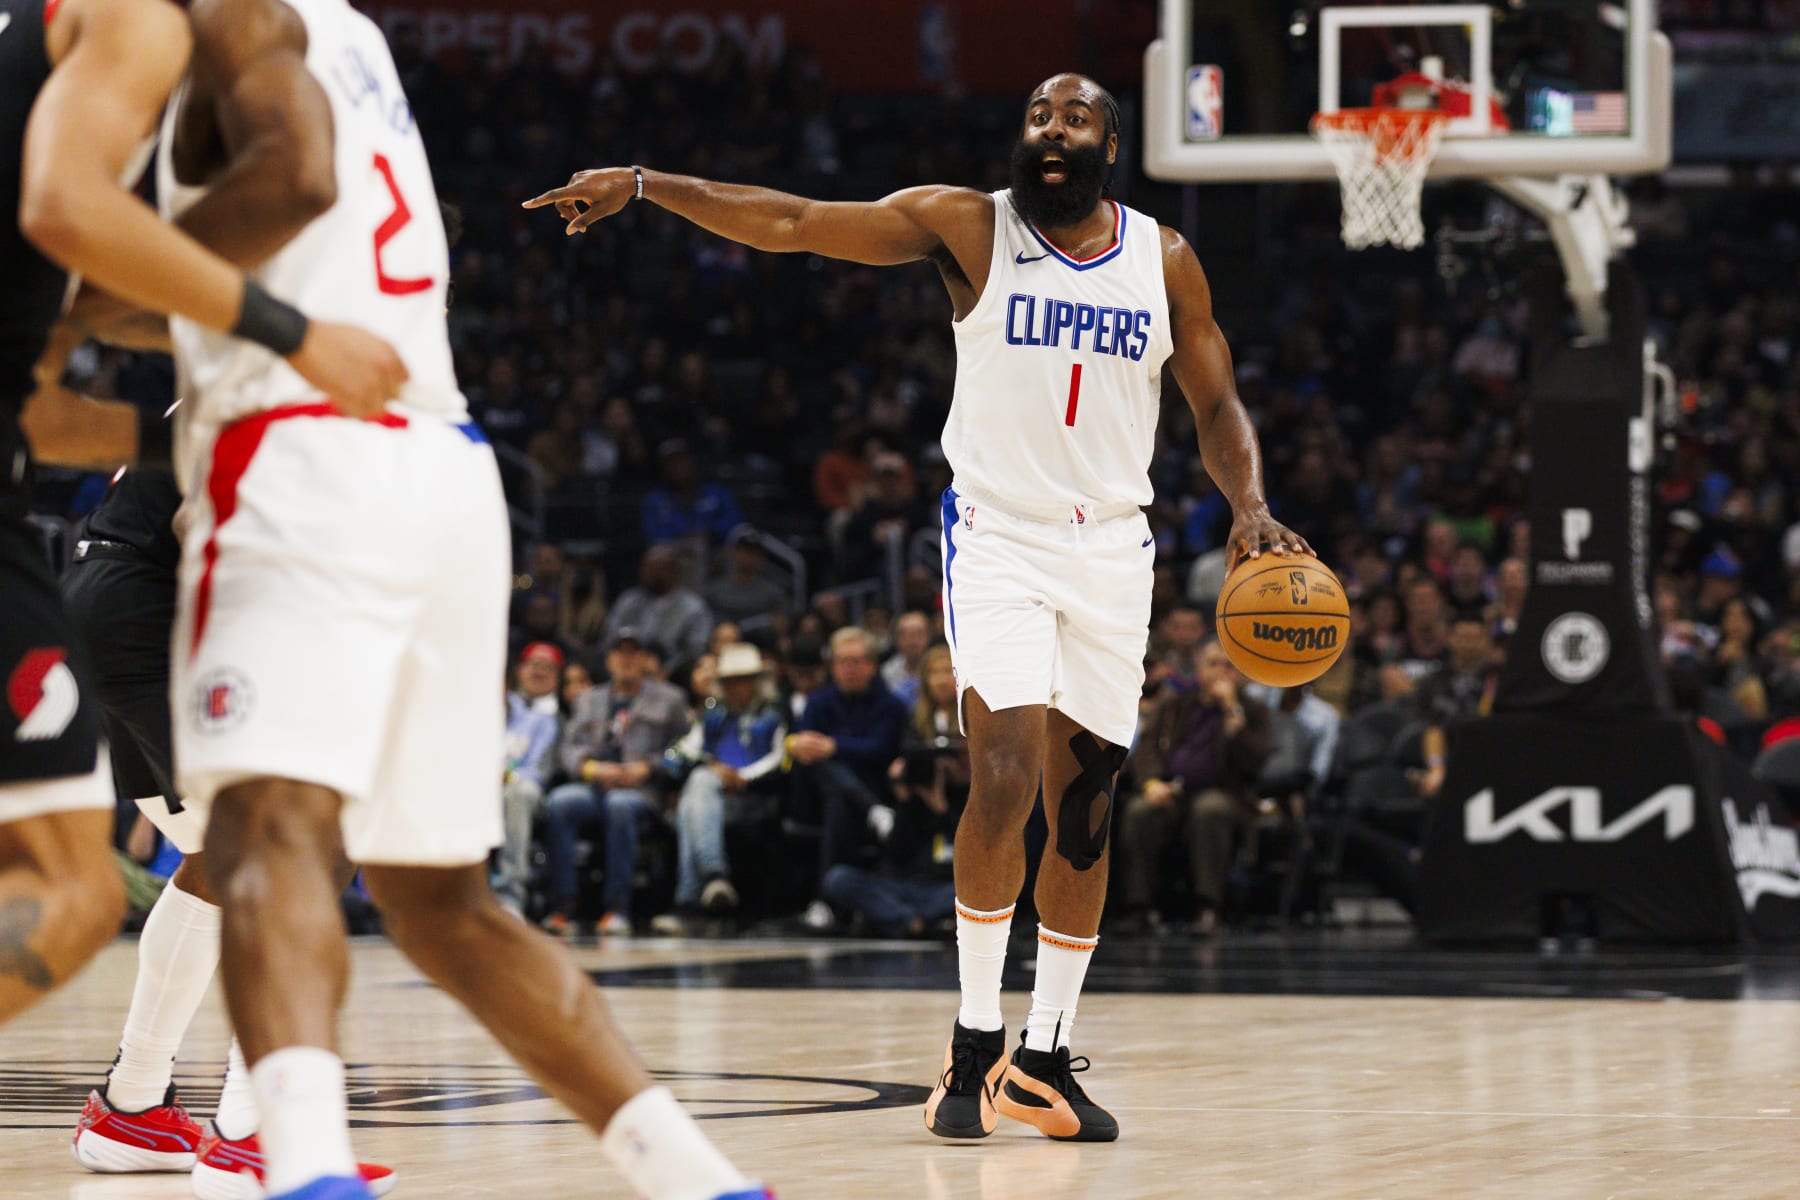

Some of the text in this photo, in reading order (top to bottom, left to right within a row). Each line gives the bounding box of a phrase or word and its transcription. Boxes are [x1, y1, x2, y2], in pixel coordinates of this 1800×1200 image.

[372, 151, 435, 296] 2
[1005, 293, 1151, 362] CLIPPERS
[1065, 363, 1083, 427] 1
[1253, 621, 1337, 651] Wilson
[1463, 784, 1695, 844] KIA
